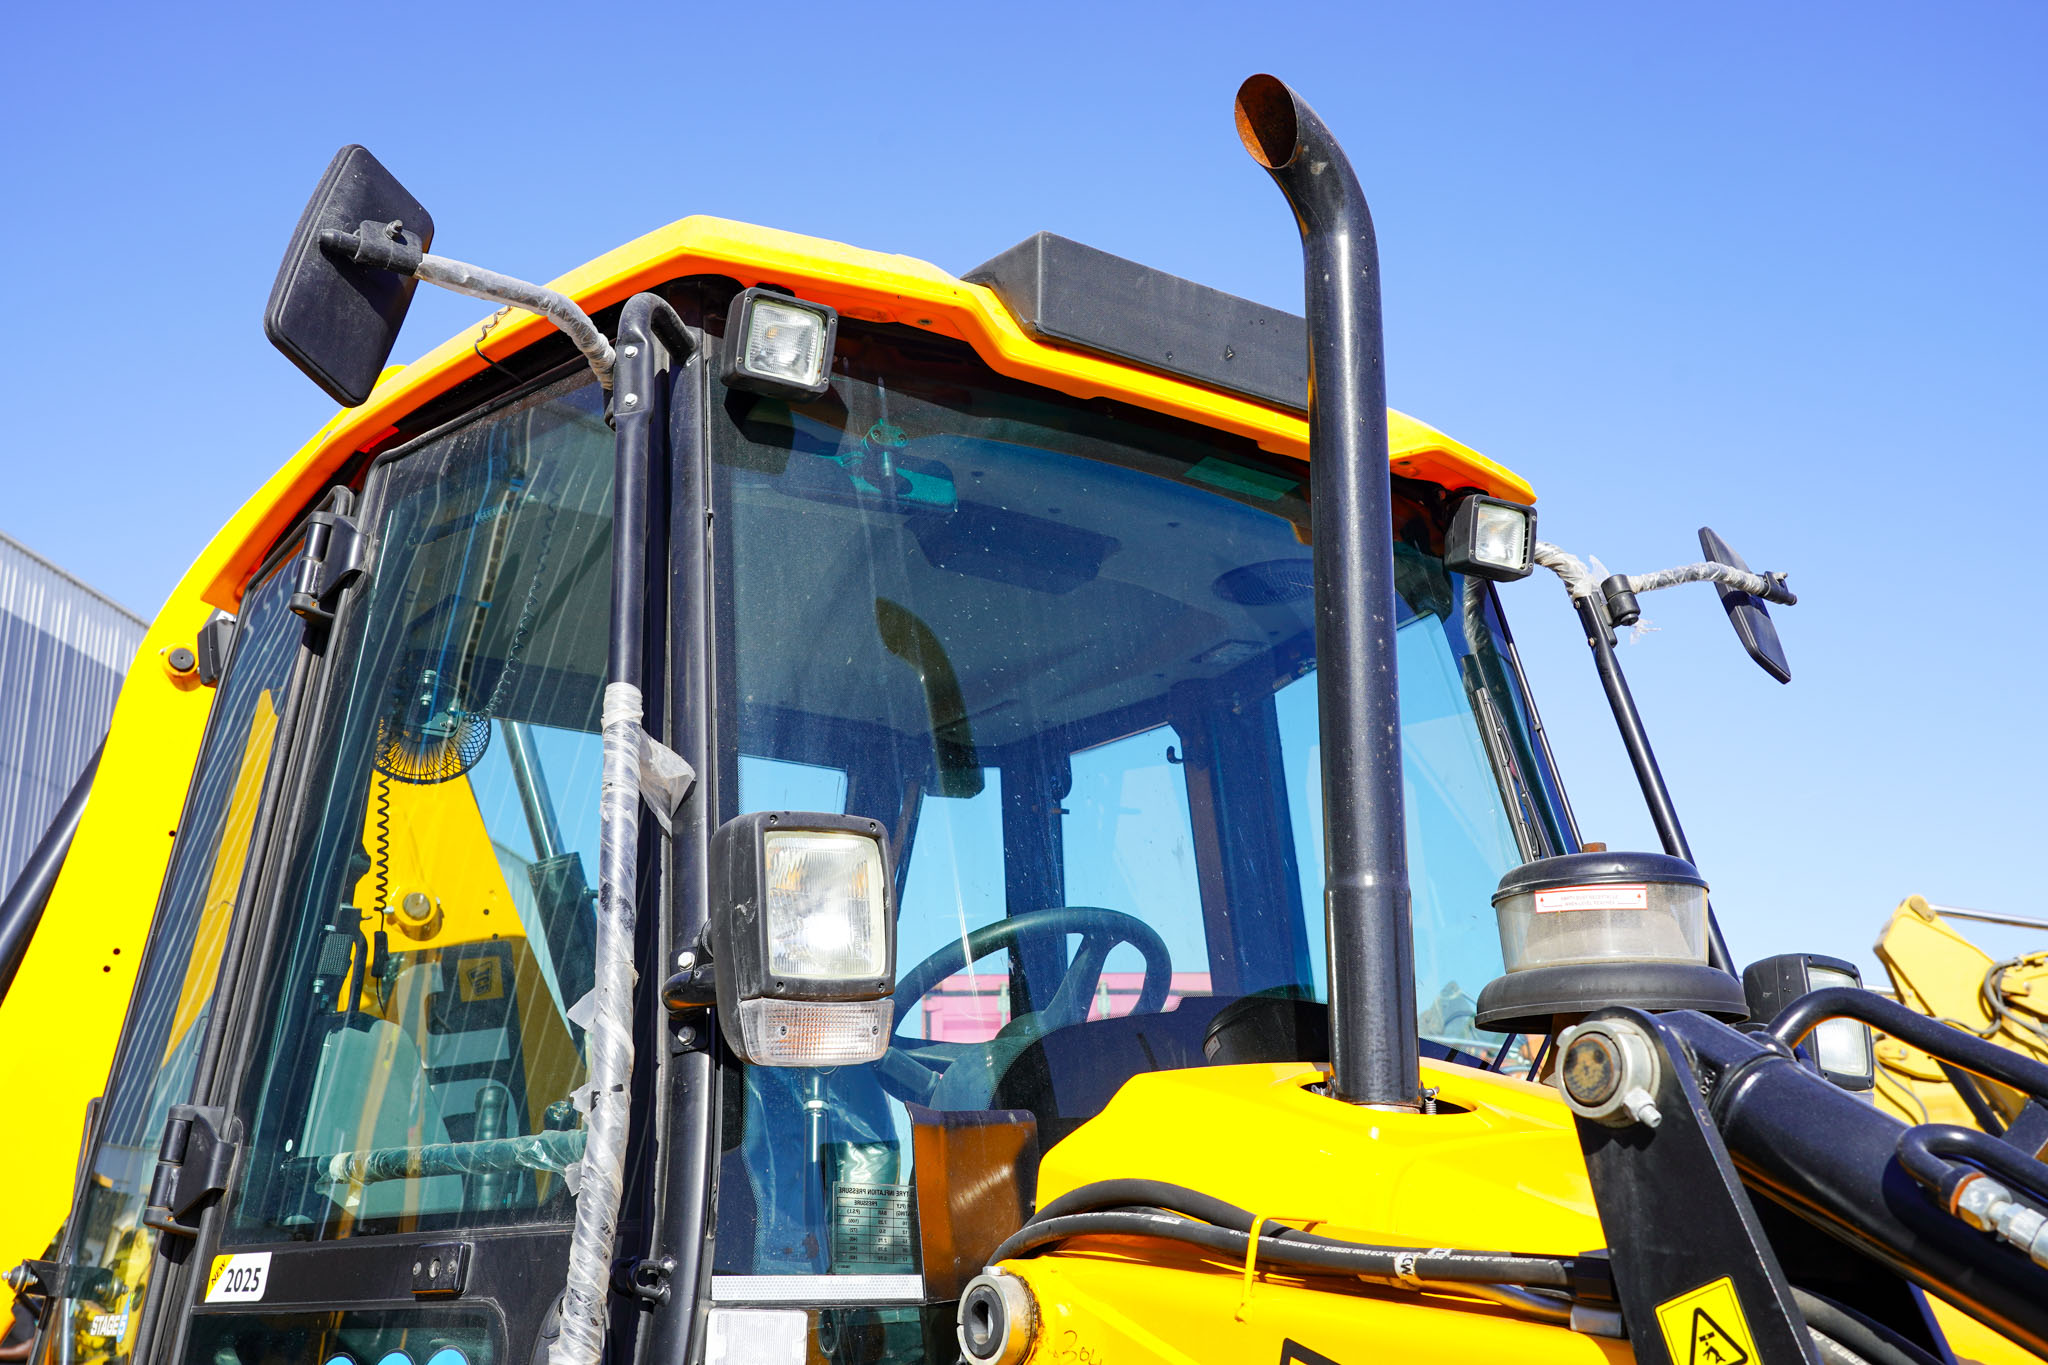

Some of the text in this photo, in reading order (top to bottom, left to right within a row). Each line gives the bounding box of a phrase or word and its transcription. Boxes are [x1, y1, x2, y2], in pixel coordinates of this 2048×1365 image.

[211, 1259, 226, 1285] NEW
[224, 1267, 262, 1293] 2025
[90, 1315, 121, 1336] STAGE
